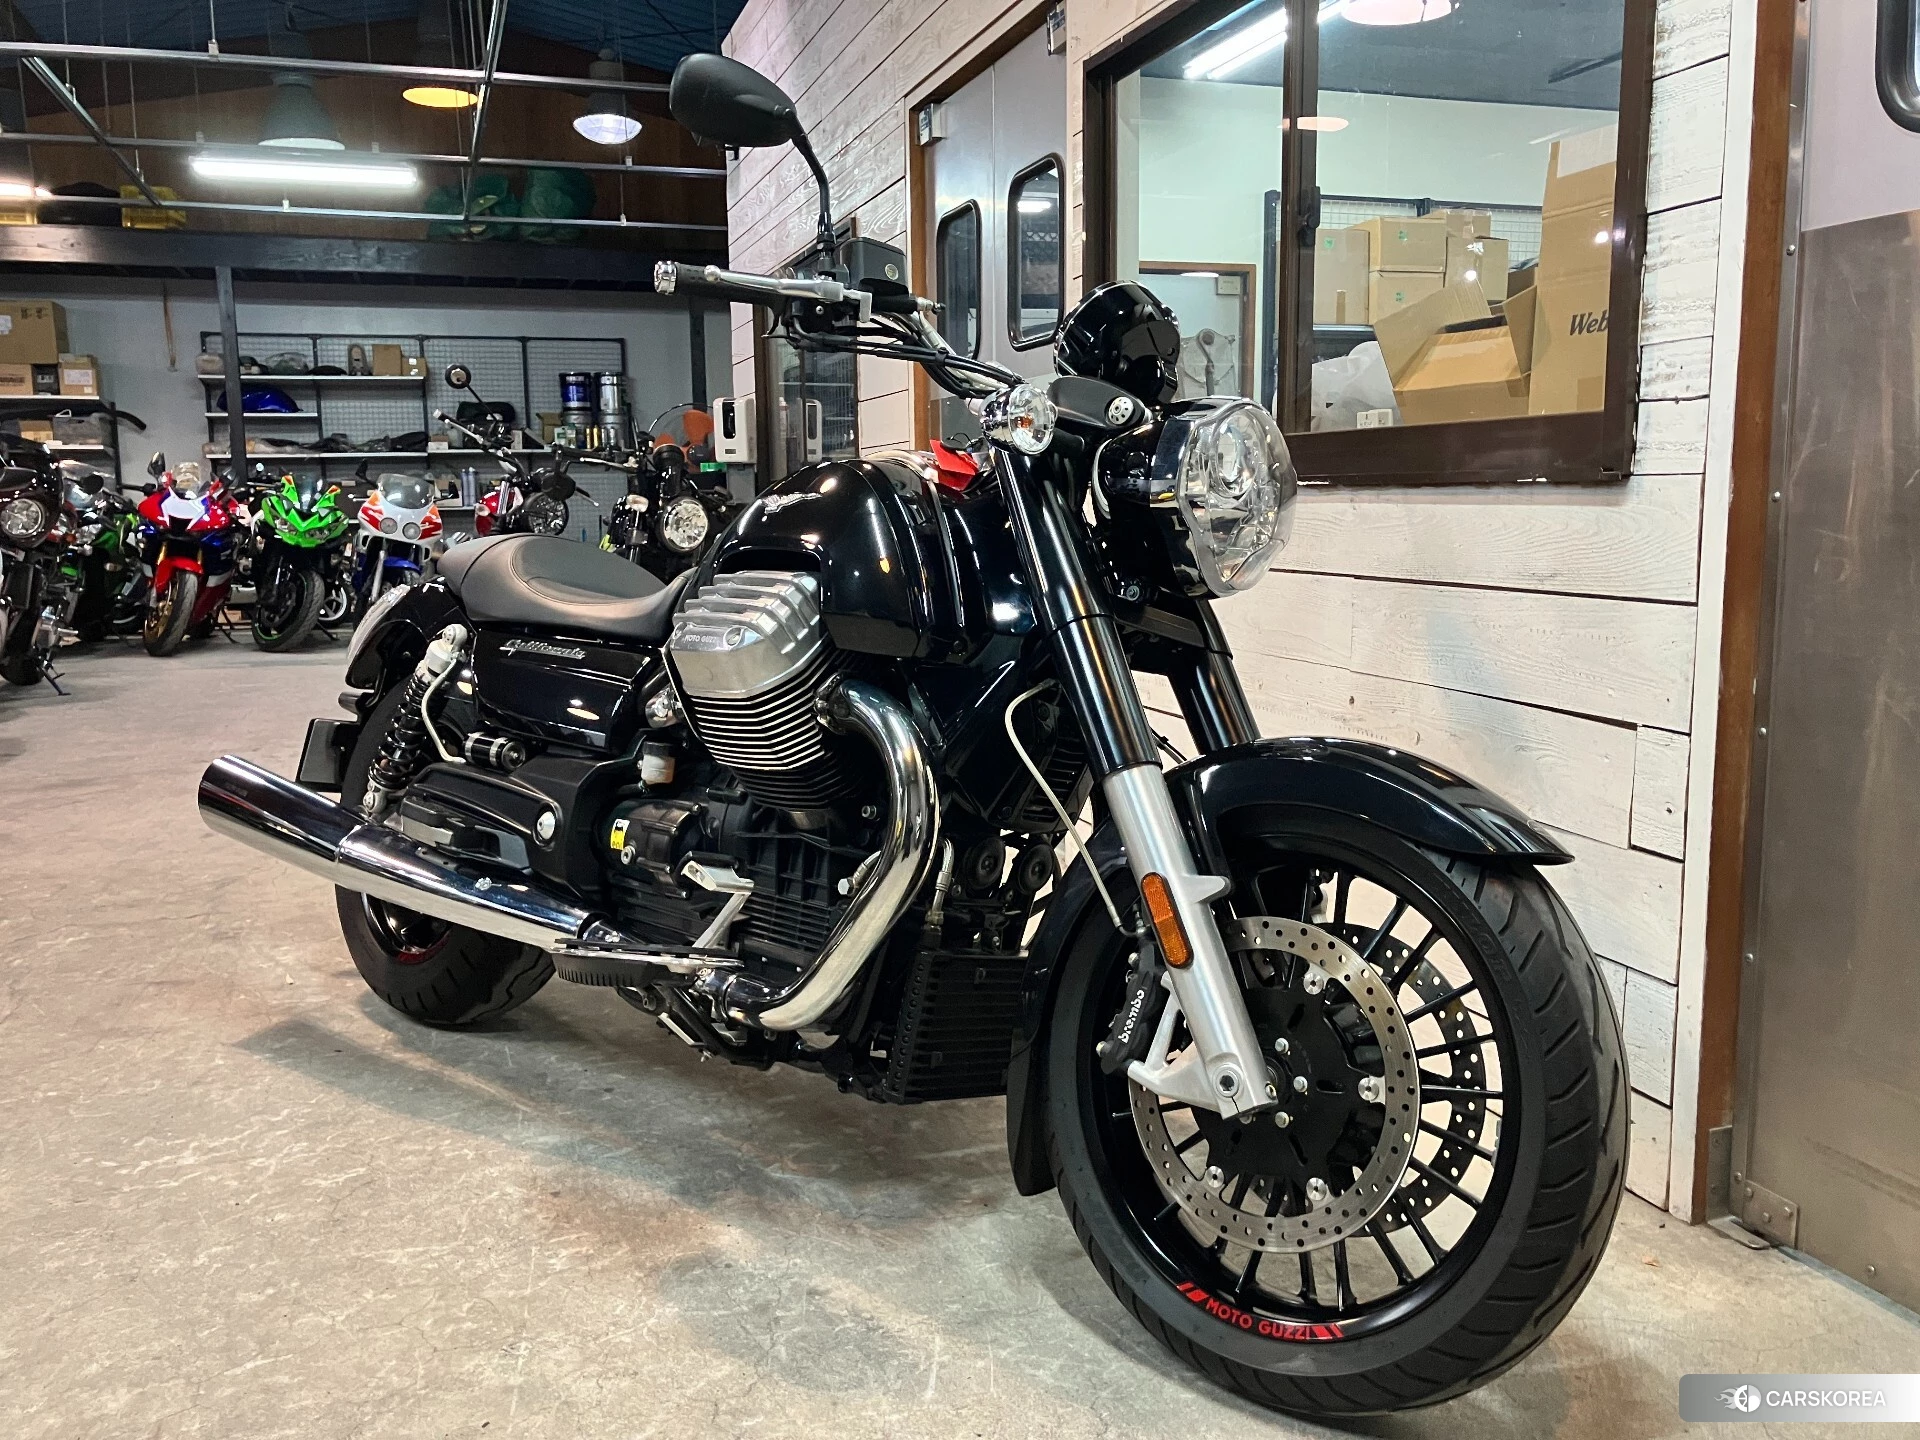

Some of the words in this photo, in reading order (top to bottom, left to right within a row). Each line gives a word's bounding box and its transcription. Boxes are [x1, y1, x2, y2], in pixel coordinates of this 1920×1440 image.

[684, 634, 700, 643] MOTO
[701, 635, 717, 643] GUZZ
[1117, 989, 1145, 1044] brembo
[1205, 1298, 1253, 1329] MOTO
[1258, 1321, 1311, 1340] GUZZI
